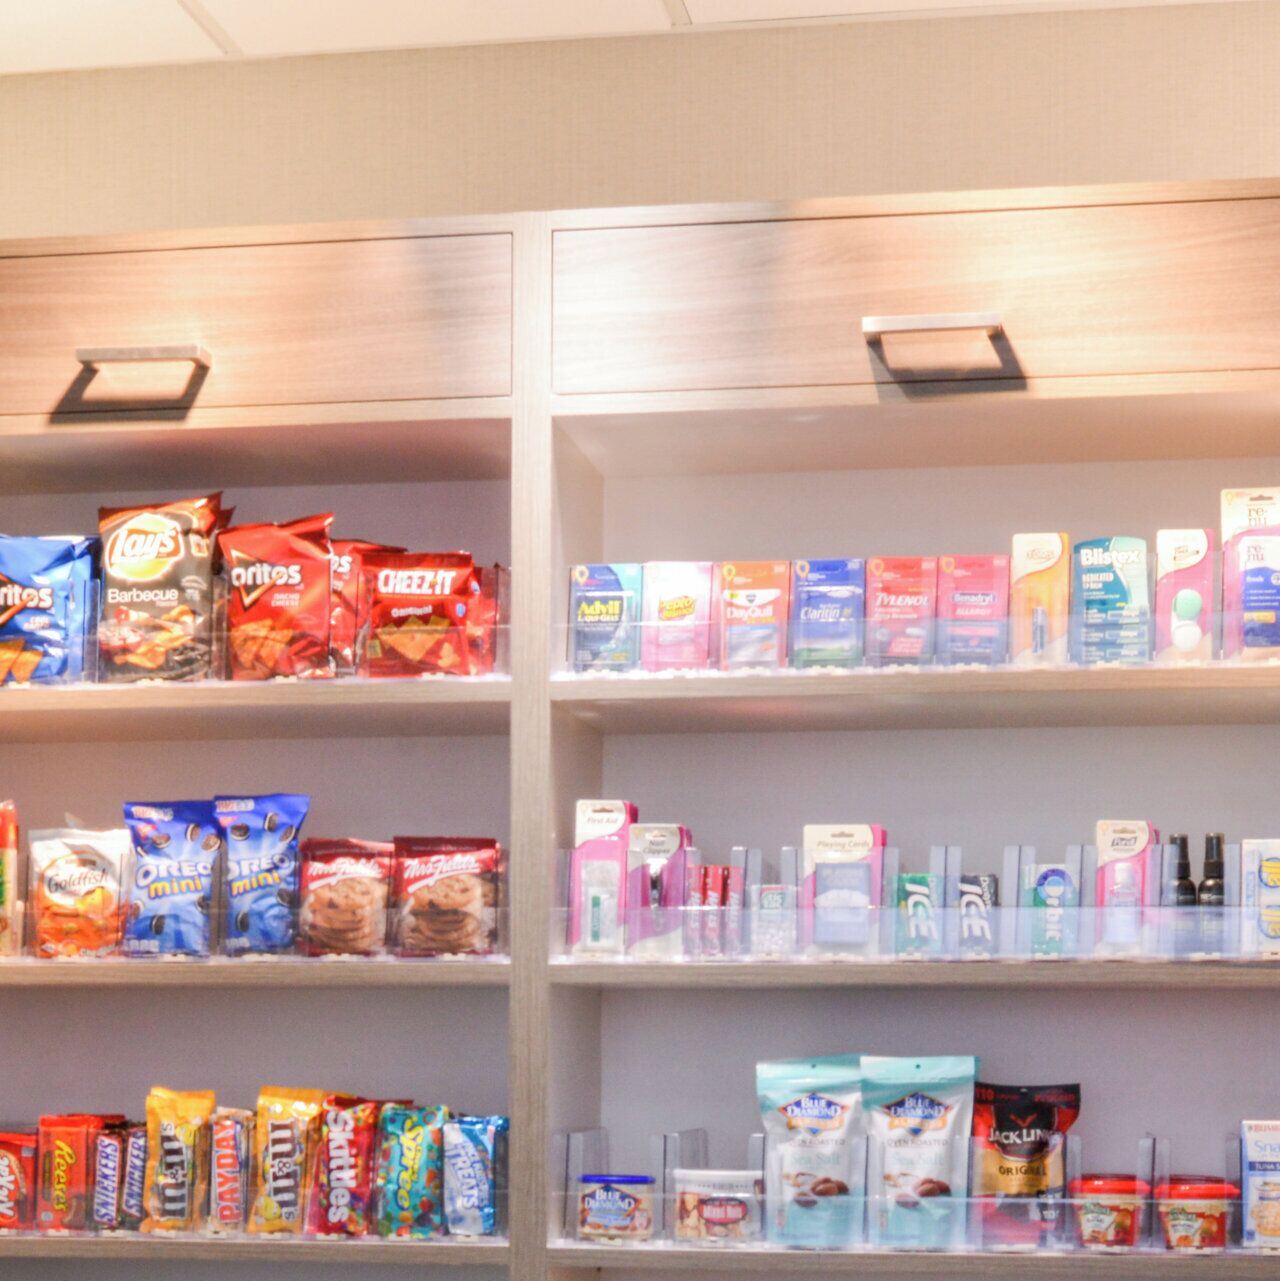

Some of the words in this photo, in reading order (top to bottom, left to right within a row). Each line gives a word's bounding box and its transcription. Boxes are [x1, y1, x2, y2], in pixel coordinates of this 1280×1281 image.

[111, 528, 180, 562] Lay's
[1080, 549, 1139, 566] Blistex
[231, 563, 302, 587] oritos
[108, 588, 179, 602] Barbecue
[876, 593, 930, 607] TYLENOL
[953, 593, 995, 604] Benadryl
[578, 600, 622, 616] Advil
[727, 606, 773, 620] DayQuil
[800, 606, 840, 619] Claritin
[47, 871, 109, 895] Goldfish
[136, 860, 212, 888] OREO
[231, 872, 281, 898] mini
[149, 876, 203, 899] mini
[905, 882, 938, 941] ICE
[958, 882, 992, 941] ICE
[786, 1105, 842, 1117] DIAMOND
[801, 1097, 828, 1108] BLUE
[891, 1105, 945, 1117] DIAMOND
[213, 1121, 242, 1224] PAYDAY
[326, 1109, 357, 1223] Skittles
[396, 1117, 424, 1210] Spree
[95, 1138, 118, 1223] SNICKERS
[585, 1198, 635, 1209] DIAMOND
